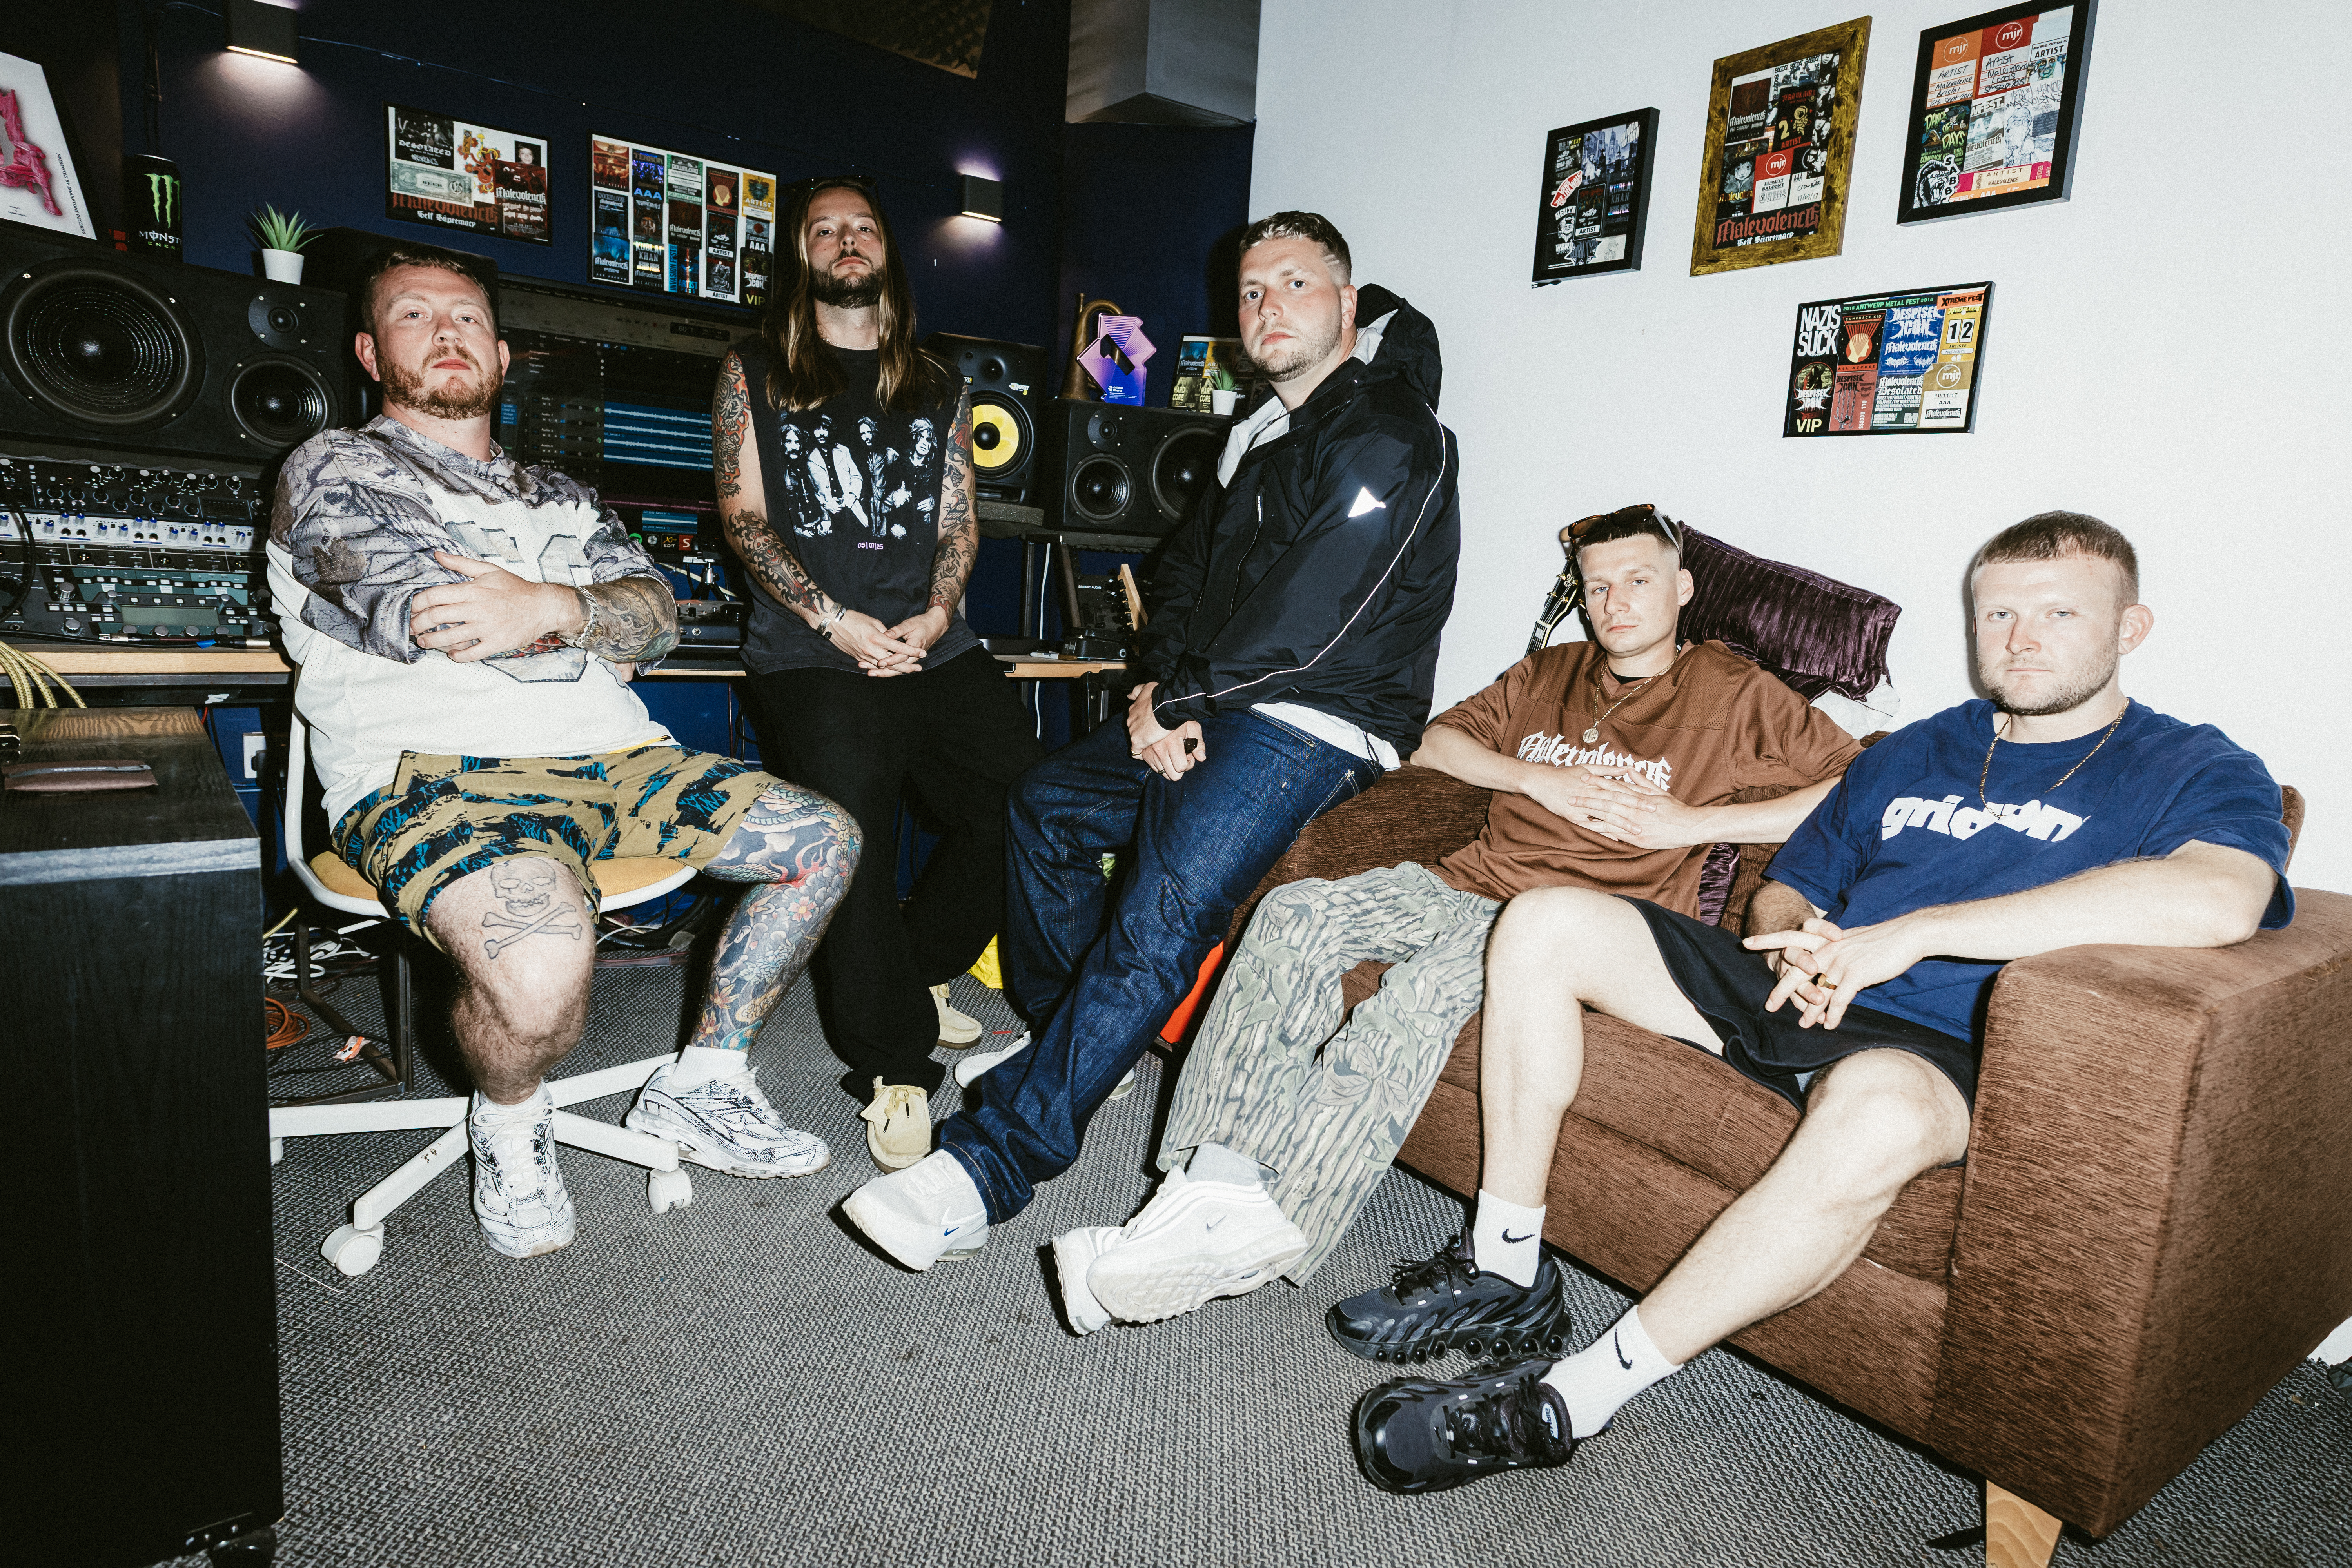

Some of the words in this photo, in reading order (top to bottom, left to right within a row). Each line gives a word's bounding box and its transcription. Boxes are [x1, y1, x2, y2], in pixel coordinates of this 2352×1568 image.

[2002, 28, 2022, 40] mjr
[1949, 42, 1968, 54] mjr
[2034, 45, 2064, 58] ARTIST
[1937, 65, 1969, 80] ARTIST
[1935, 77, 1972, 91] Malevolence
[1936, 86, 1961, 98] Bristol
[1925, 111, 1947, 134] DANCE
[1942, 122, 1951, 134] OF
[1779, 120, 1789, 140] 2
[1781, 136, 1802, 149] ARTIST
[1942, 130, 1965, 152] DAYS
[399, 139, 451, 156] DESOLATED
[1770, 158, 1786, 169] mjr
[1987, 168, 2023, 177] ARTIST
[1988, 177, 2018, 185] MALEVOLENCE
[496, 186, 547, 205] Malevolence
[634, 188, 662, 200] AAA
[1611, 192, 1630, 203] KHAN
[1767, 194, 1786, 202] SLEEPS
[745, 198, 772, 208] ARTIST
[67, 186, 79, 213] SHARPTONE
[76, 214, 86, 234] RECORDS
[417, 210, 434, 219] Self
[1716, 203, 1820, 246] Malevolence
[750, 241, 766, 252] AAA
[639, 251, 658, 262] KHAN
[679, 279, 698, 289] ARTIST
[746, 294, 766, 305] VIP
[1855, 301, 1884, 310] ANTWERP
[1941, 297, 1967, 307] XTREME
[1968, 292, 1985, 302] FEST
[1800, 305, 1841, 332] NAZIS
[1950, 321, 1973, 339] 12
[1797, 329, 1839, 356] SUCK
[1884, 339, 1938, 355] Malevolence
[1879, 375, 1924, 387] Malevolence
[1942, 370, 1960, 382] mjr
[1877, 386, 1923, 396] Desolated
[1926, 408, 1960, 418] Malevolence
[1797, 418, 1822, 432] VIP
